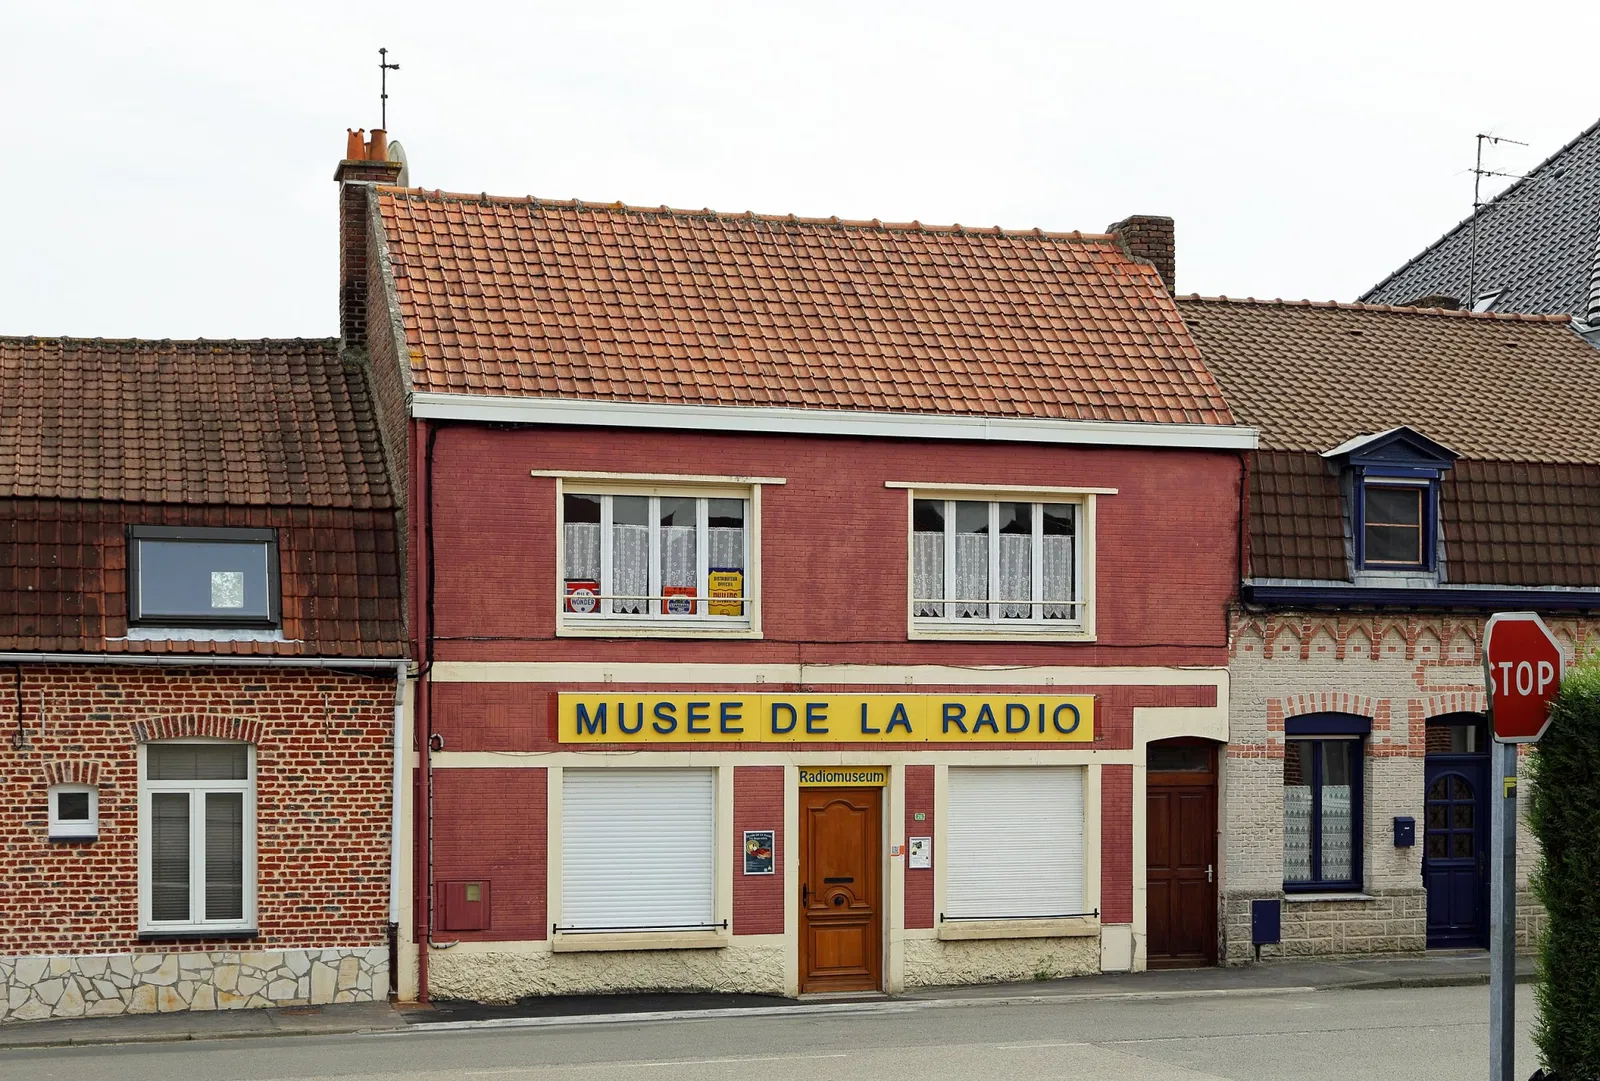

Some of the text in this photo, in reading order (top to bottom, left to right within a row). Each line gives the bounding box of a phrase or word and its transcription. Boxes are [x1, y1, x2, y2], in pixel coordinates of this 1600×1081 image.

[572, 598, 595, 606] WONDER
[576, 702, 1081, 734] MUSEE DE LA RADIO
[799, 769, 884, 783] Radiomuseum
